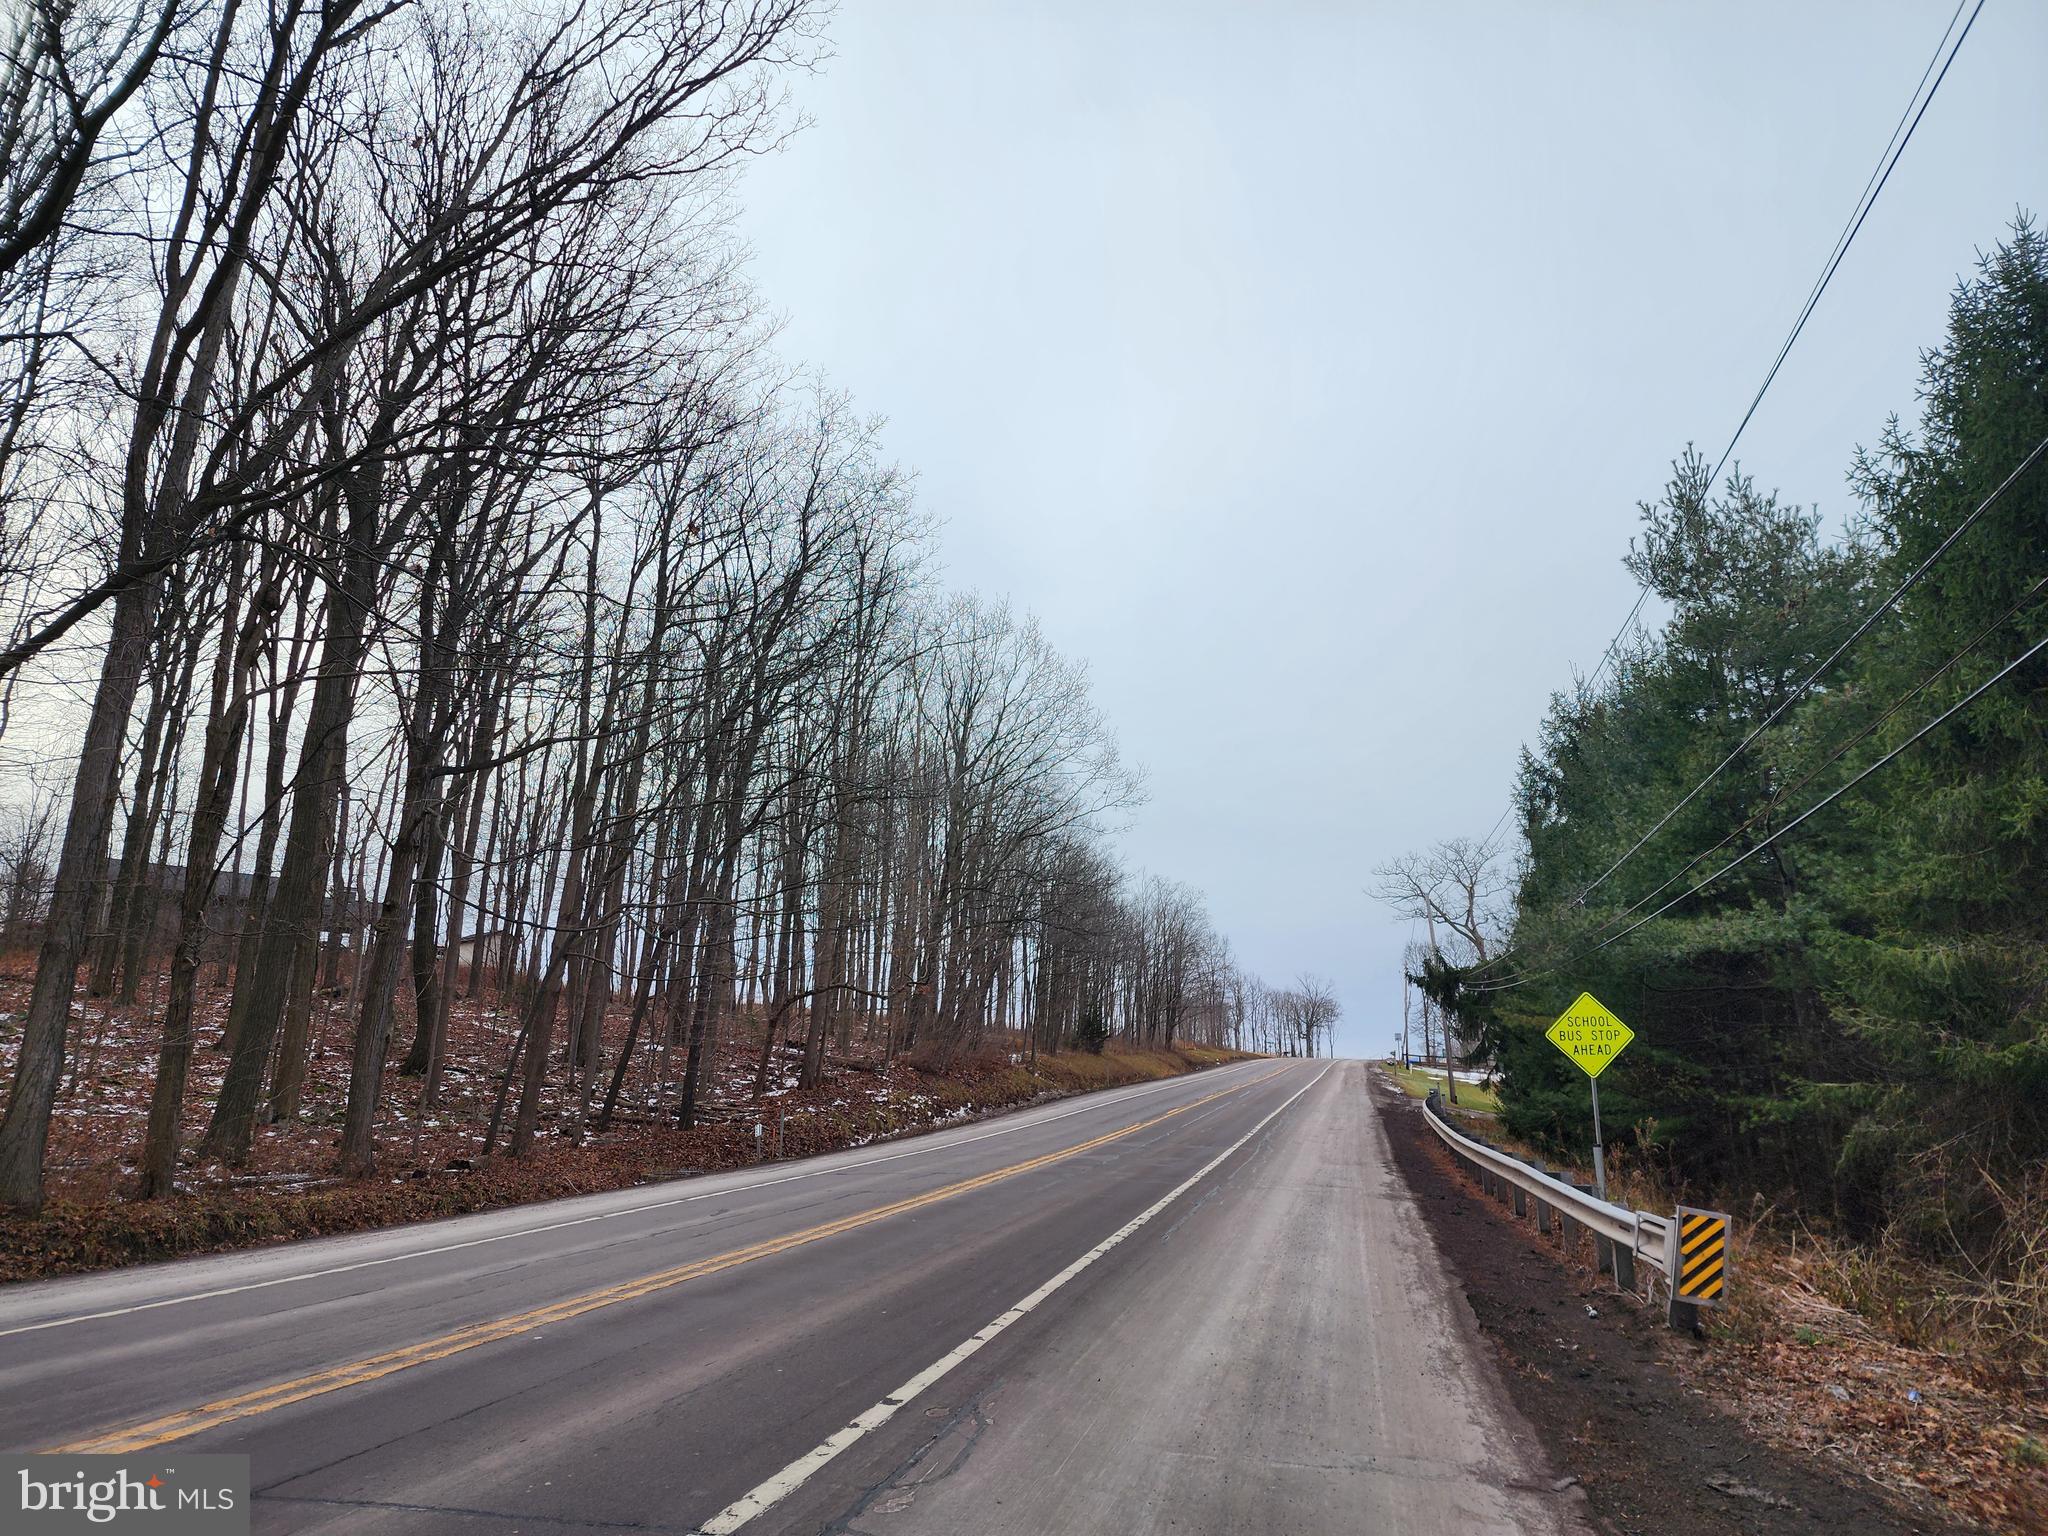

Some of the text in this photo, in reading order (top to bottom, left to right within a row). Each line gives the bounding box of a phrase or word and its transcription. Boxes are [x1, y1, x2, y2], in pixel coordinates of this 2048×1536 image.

[1567, 1016, 1612, 1027] SCHOOL
[1559, 1030, 1620, 1041] BUS STOP
[1573, 1044, 1612, 1055] AHEAD
